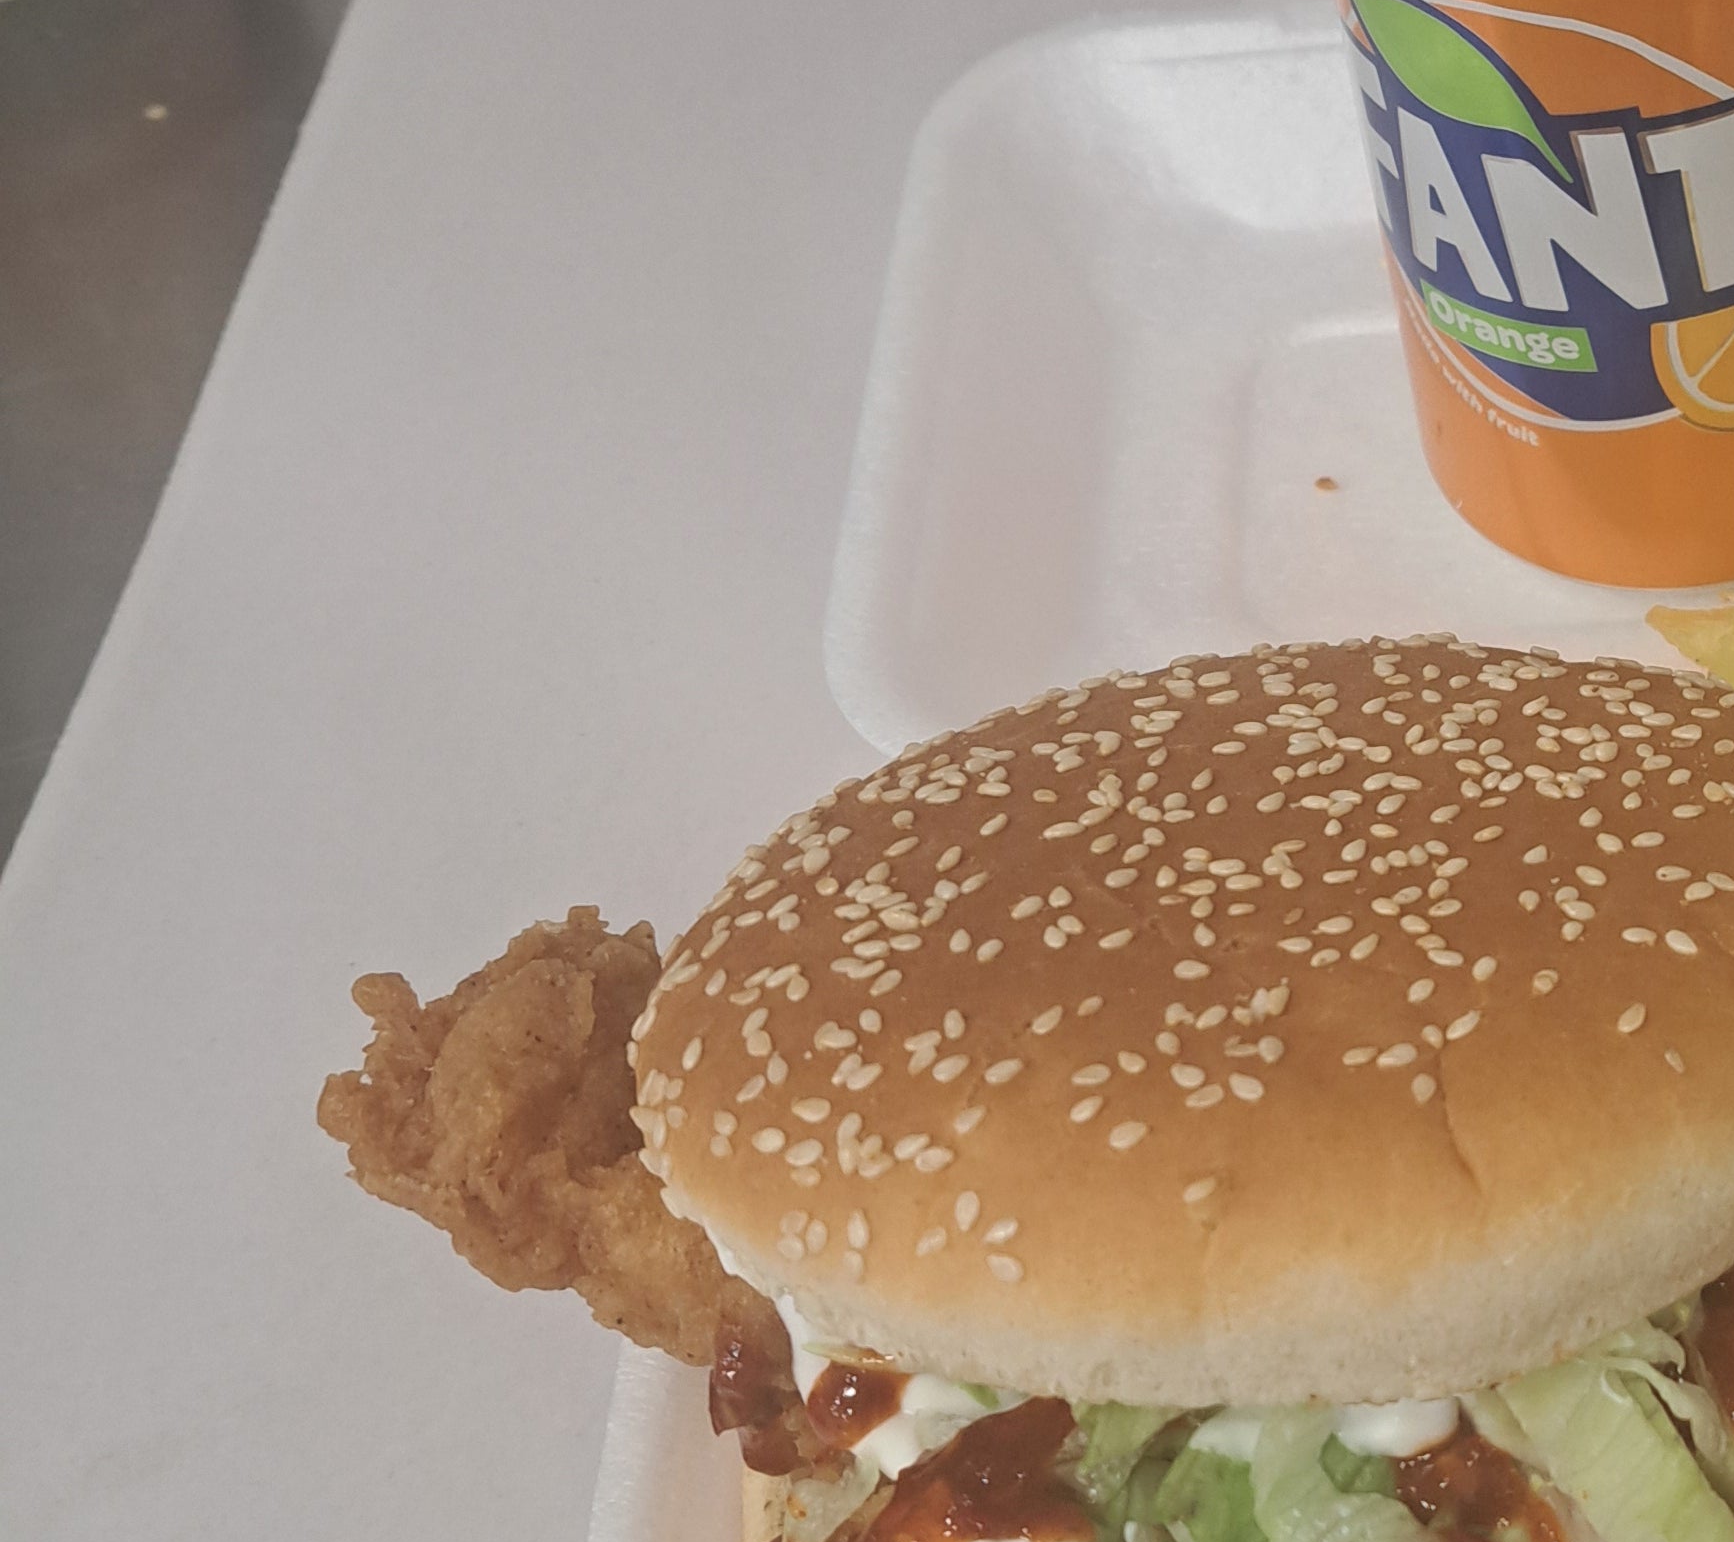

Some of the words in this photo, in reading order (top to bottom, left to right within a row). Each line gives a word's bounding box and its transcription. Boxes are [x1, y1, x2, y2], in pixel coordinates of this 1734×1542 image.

[1429, 291, 1581, 364] Orange
[1442, 365, 1484, 414] with
[1487, 408, 1541, 447] fruit
